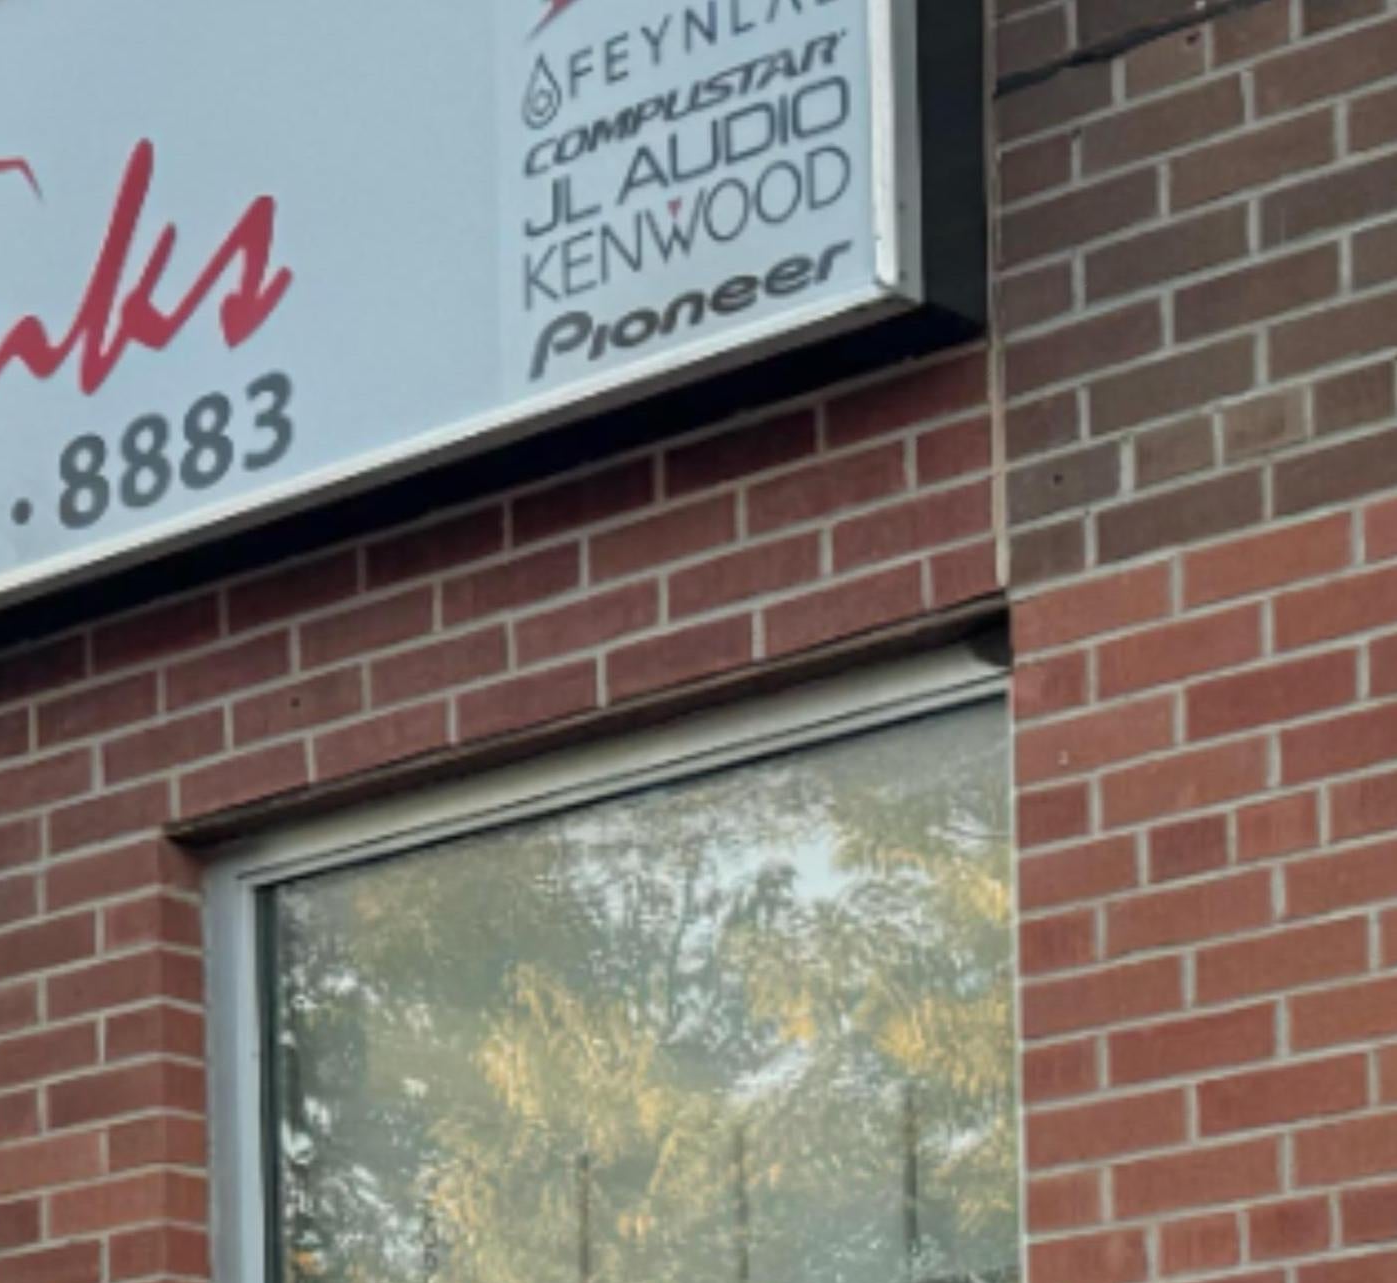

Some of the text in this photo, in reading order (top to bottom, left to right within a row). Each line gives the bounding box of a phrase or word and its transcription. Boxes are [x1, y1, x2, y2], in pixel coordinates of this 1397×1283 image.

[522, 29, 848, 179] COMPUSTAR
[567, 0, 839, 100] FEYNL
[523, 75, 852, 240] JL AUDIO
[523, 144, 852, 311] KENWOOD
[528, 240, 852, 382] Pioneer
